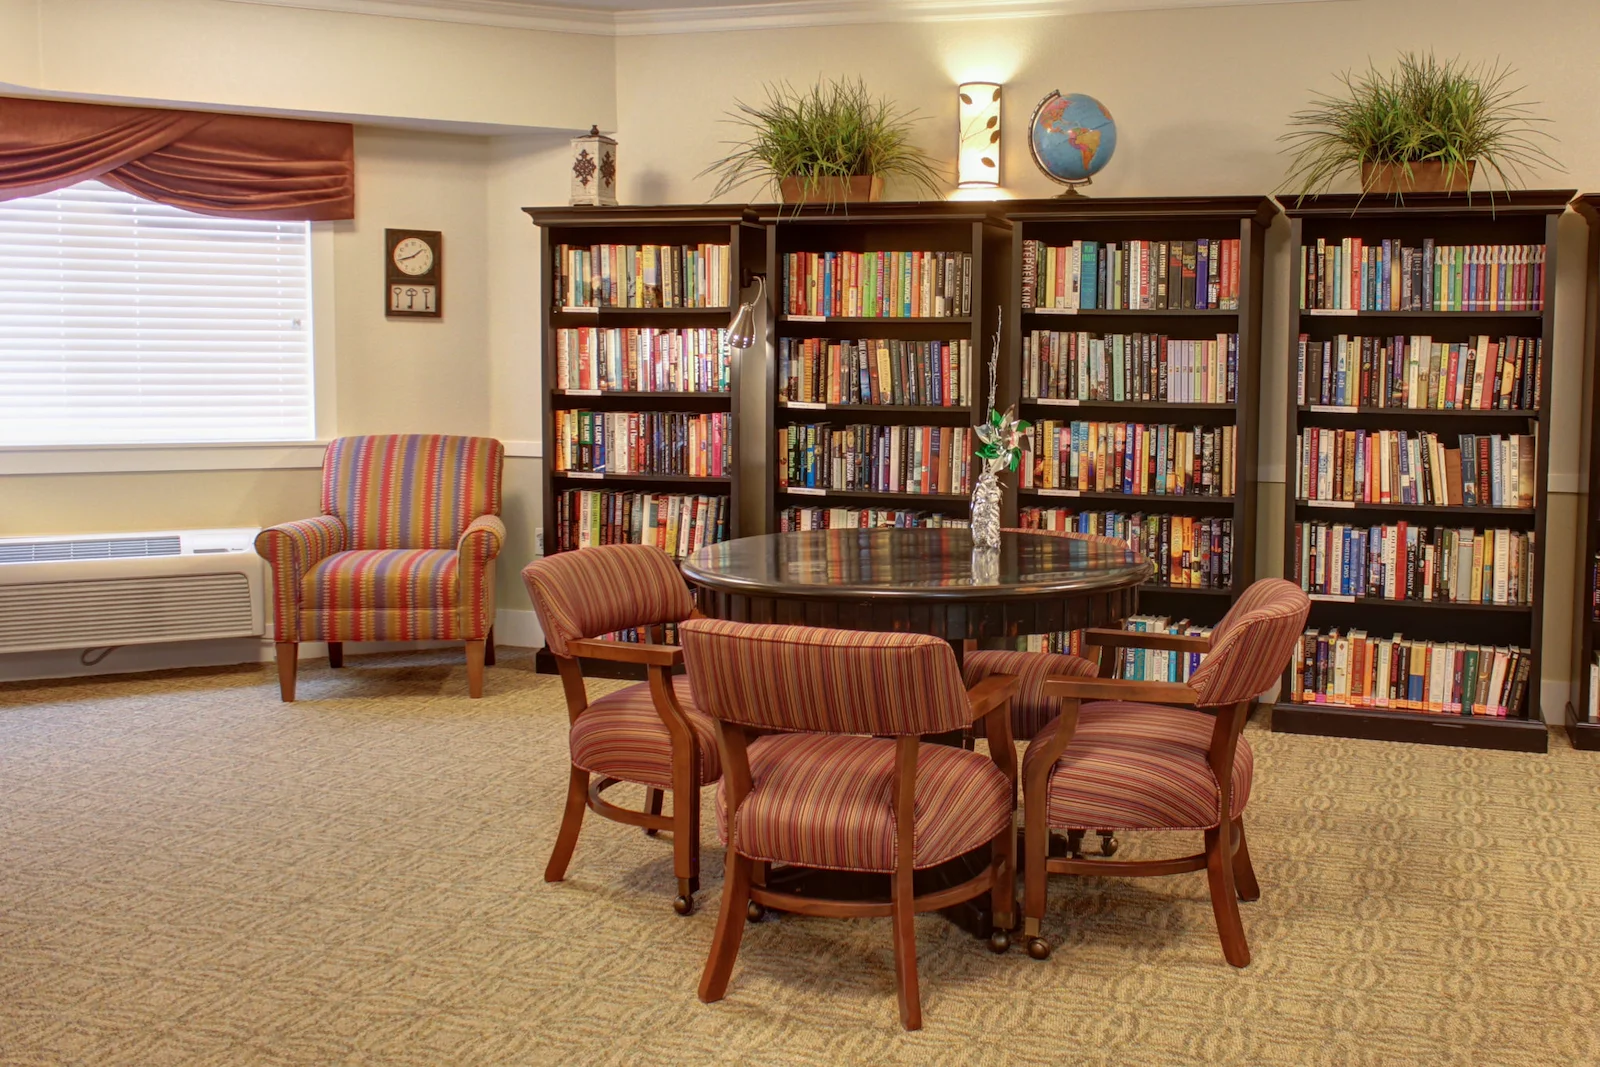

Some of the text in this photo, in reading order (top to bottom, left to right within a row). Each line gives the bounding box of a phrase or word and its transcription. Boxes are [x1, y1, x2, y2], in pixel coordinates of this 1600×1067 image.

[1021, 239, 1033, 309] STEPHEN KING
[1407, 552, 1415, 590] MY JOURNEY
